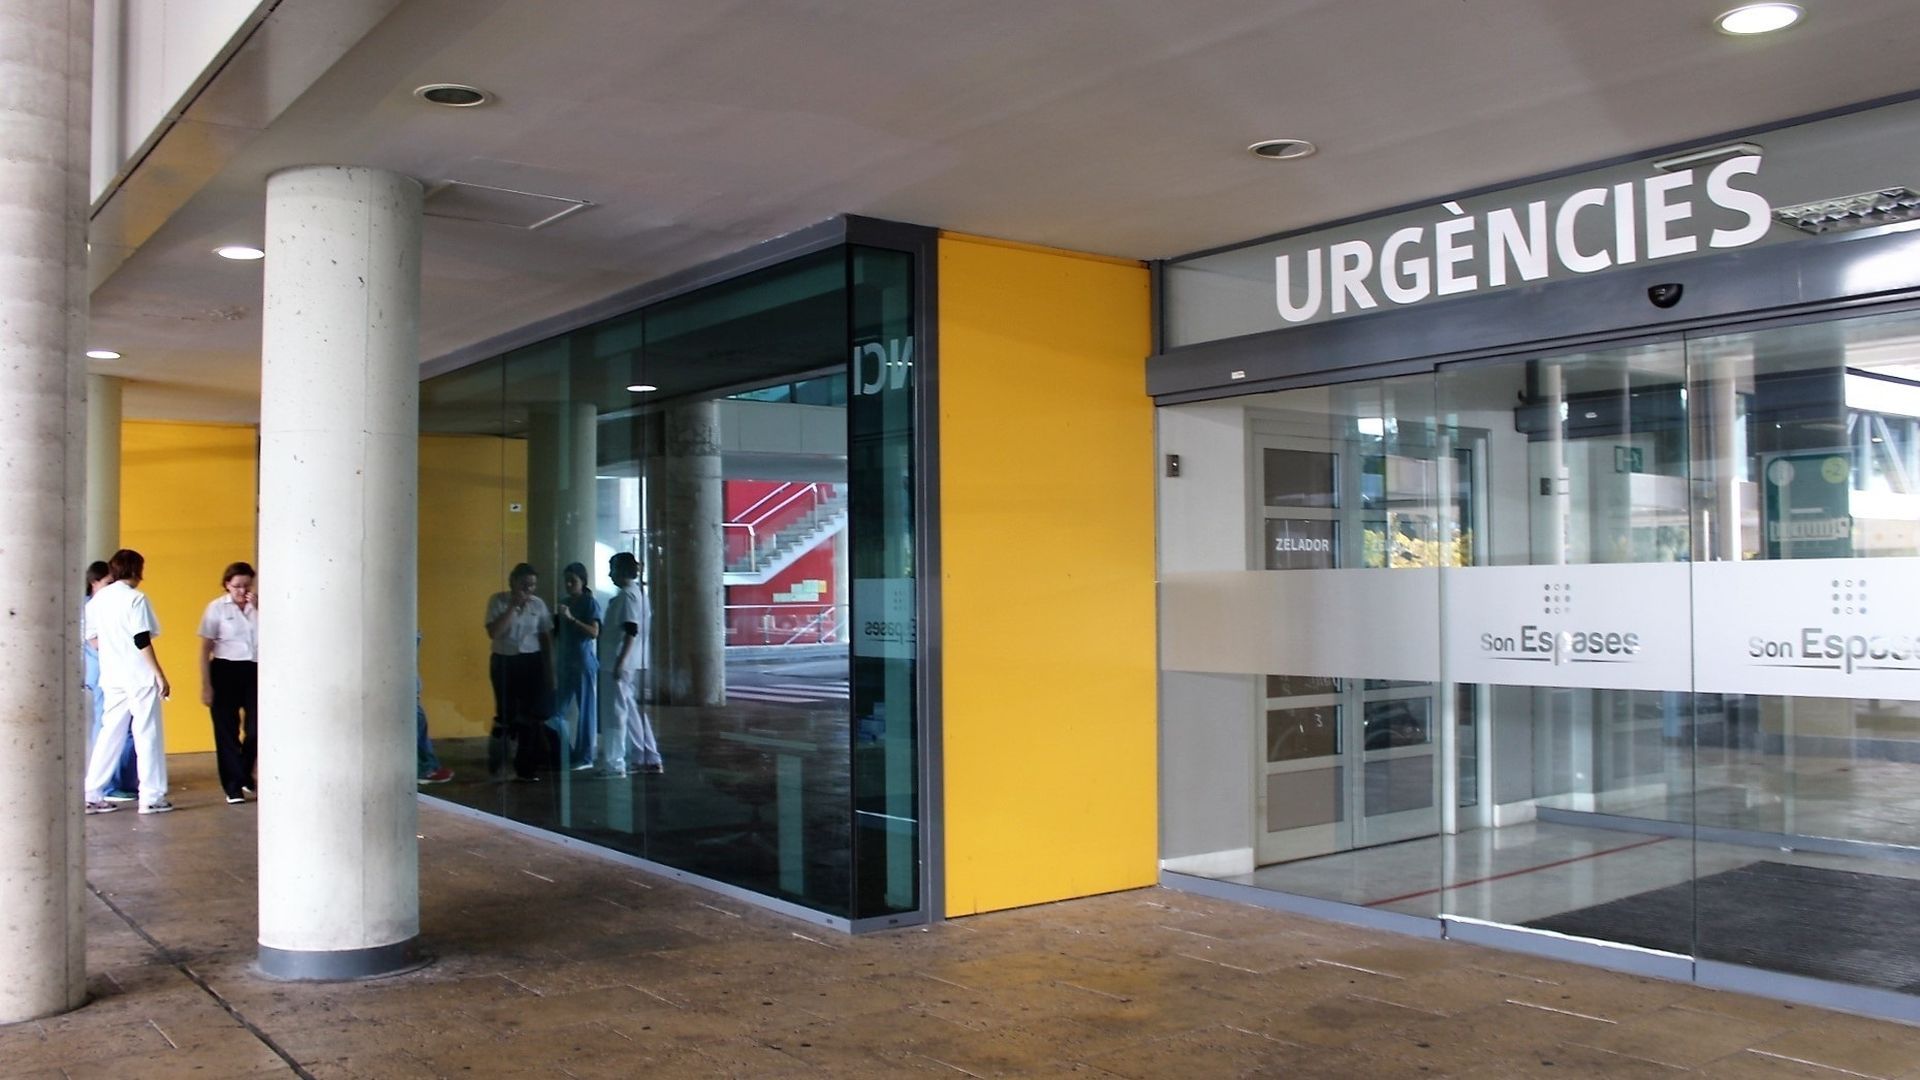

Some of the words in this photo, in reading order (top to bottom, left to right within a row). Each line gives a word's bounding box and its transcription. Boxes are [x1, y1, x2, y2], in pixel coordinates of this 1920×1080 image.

[1275, 155, 1772, 322] URGÈNCIES
[1275, 537, 1329, 552] ZELADOR
[1481, 632, 1515, 652] Son
[1749, 636, 1793, 658] Son
